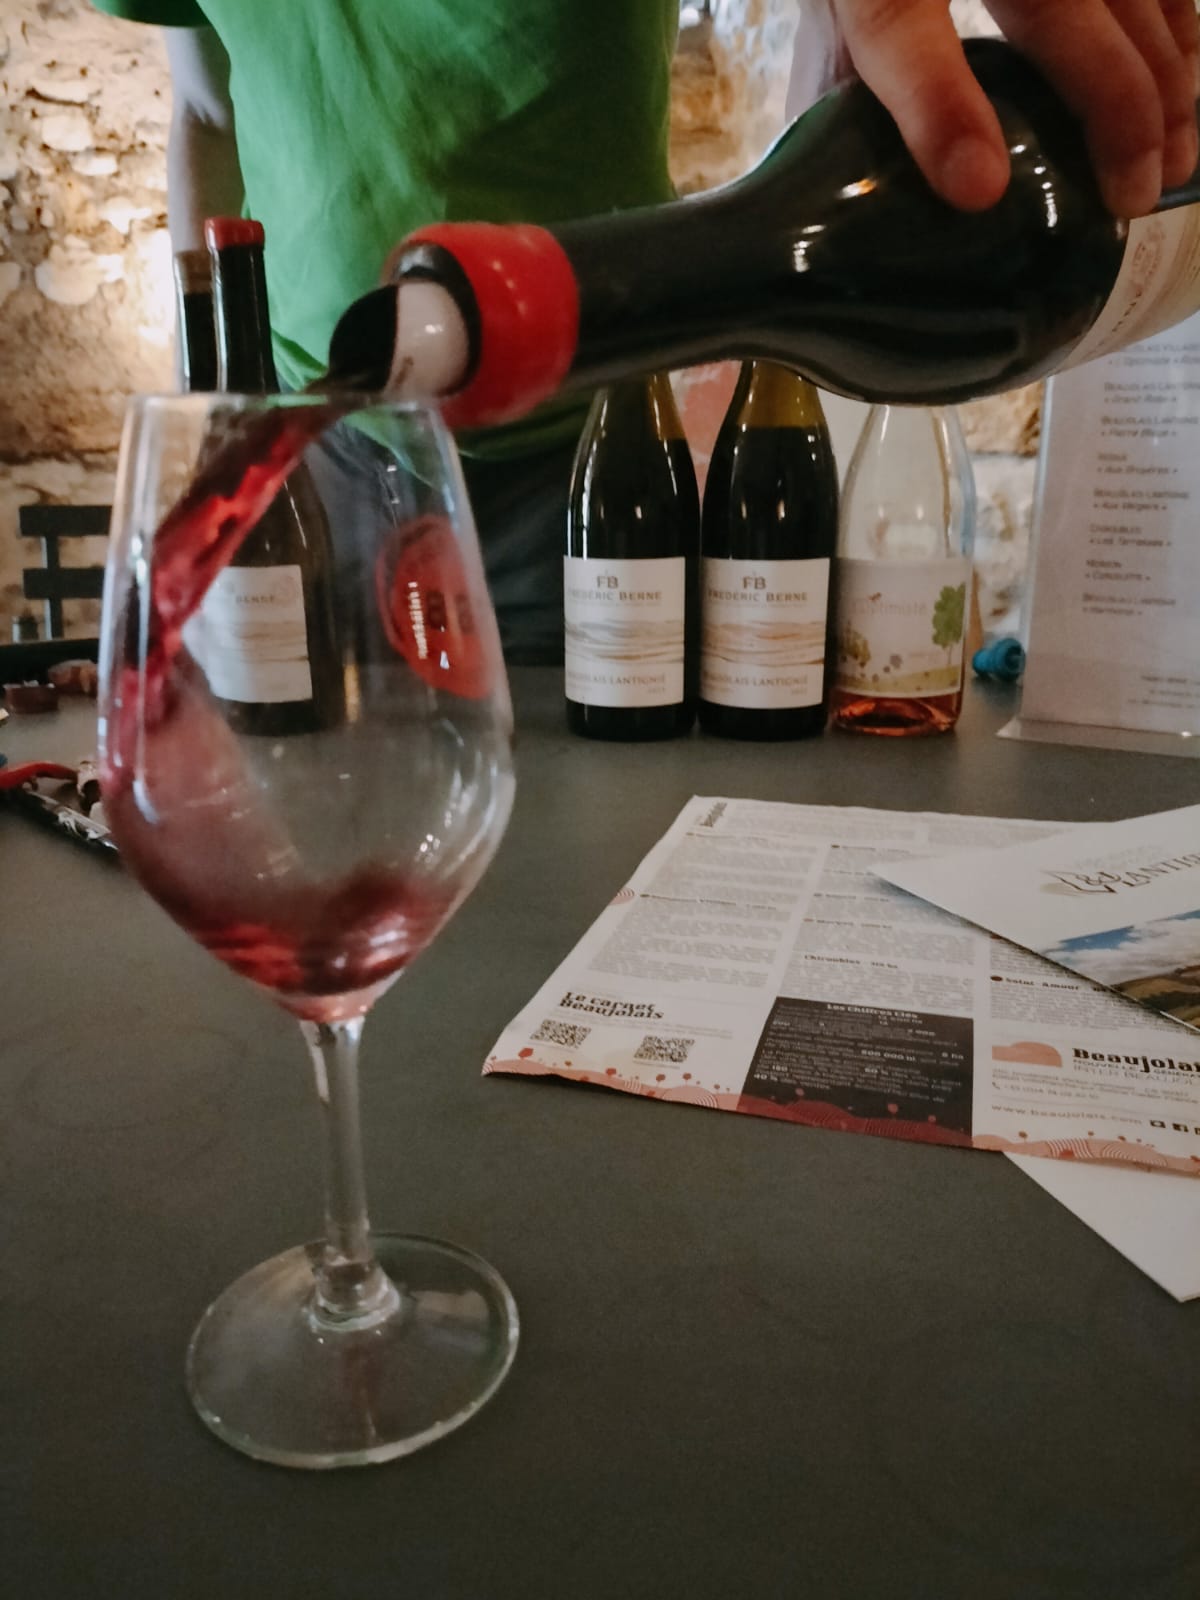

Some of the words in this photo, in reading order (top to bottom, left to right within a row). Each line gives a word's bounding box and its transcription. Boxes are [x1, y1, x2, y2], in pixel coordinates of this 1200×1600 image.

[743, 576, 766, 590] FB
[618, 591, 662, 601] BERNE
[766, 591, 808, 602] BERNE
[559, 998, 665, 1020] Beaujolais
[565, 992, 587, 1001] Le
[590, 997, 656, 1013] carnet
